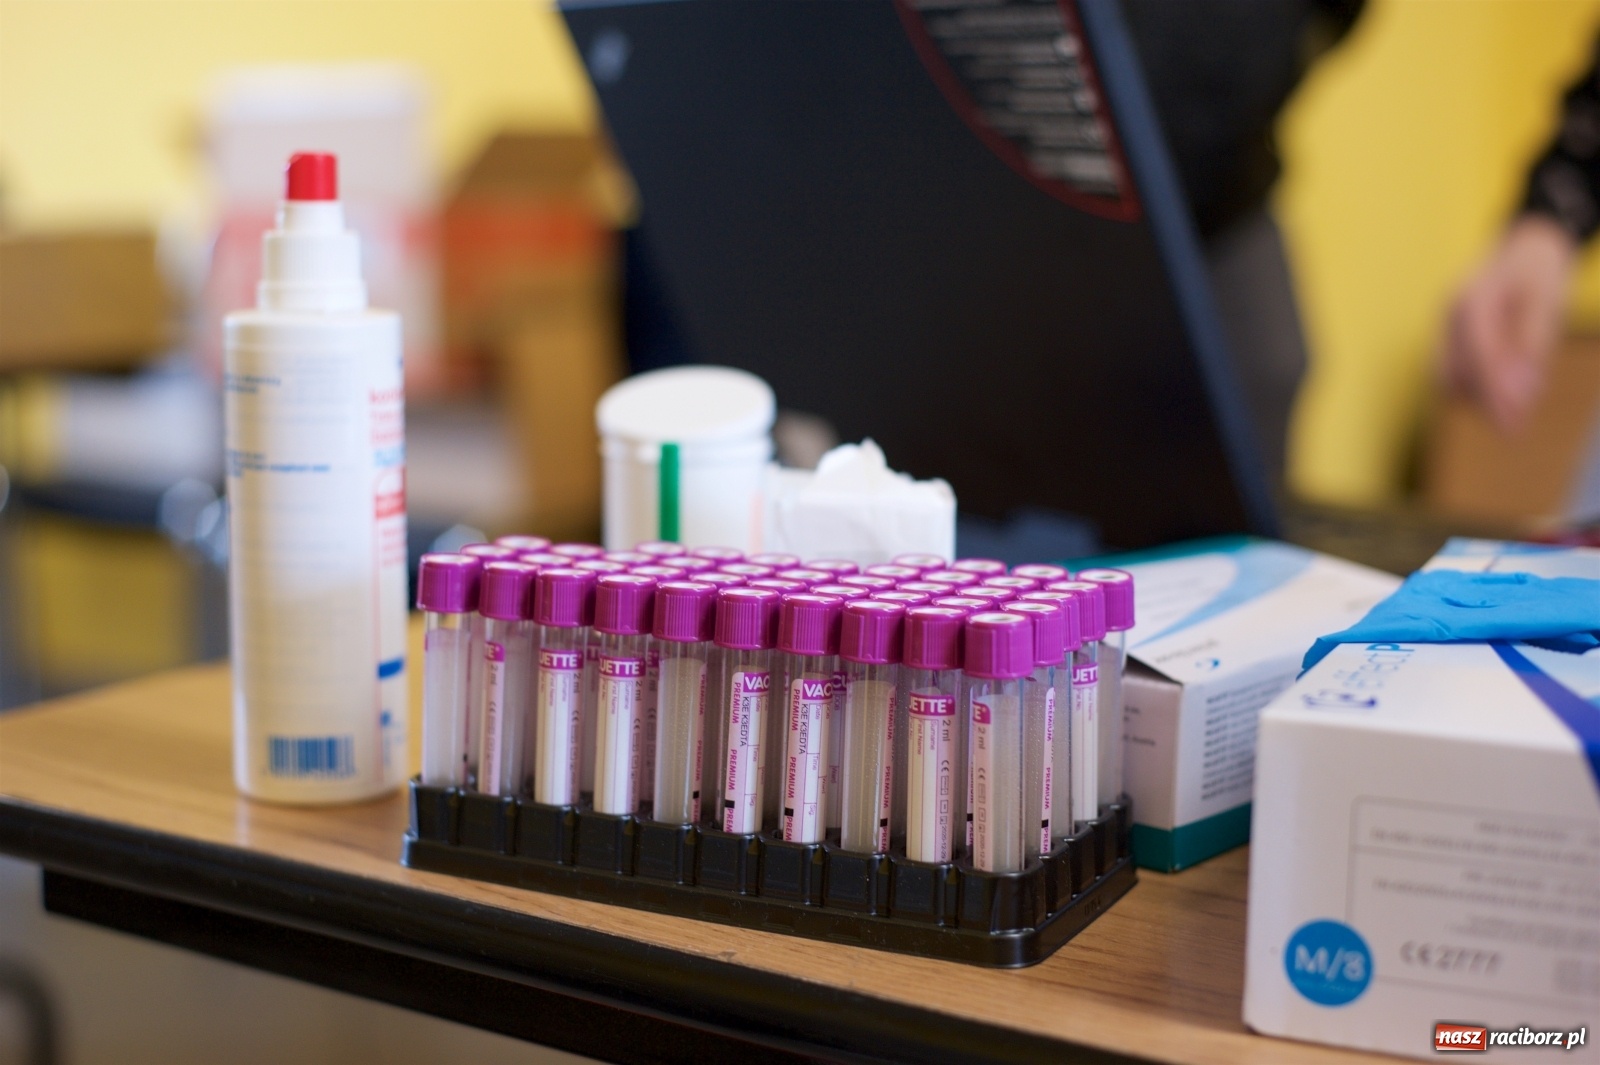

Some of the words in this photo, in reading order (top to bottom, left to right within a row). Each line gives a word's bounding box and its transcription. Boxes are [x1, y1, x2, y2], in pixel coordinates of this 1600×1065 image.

[732, 682, 741, 724] PREMIUM
[742, 696, 750, 715] K3E
[792, 689, 800, 731] PREMIUM
[740, 714, 748, 747] K3EDTA
[798, 722, 808, 754] K3EDTA
[942, 730, 950, 742] ml
[728, 749, 737, 790] PREMIUM
[788, 756, 796, 798] PREMIUM
[1295, 944, 1366, 982] M/8
[1435, 945, 1501, 976] 2777
